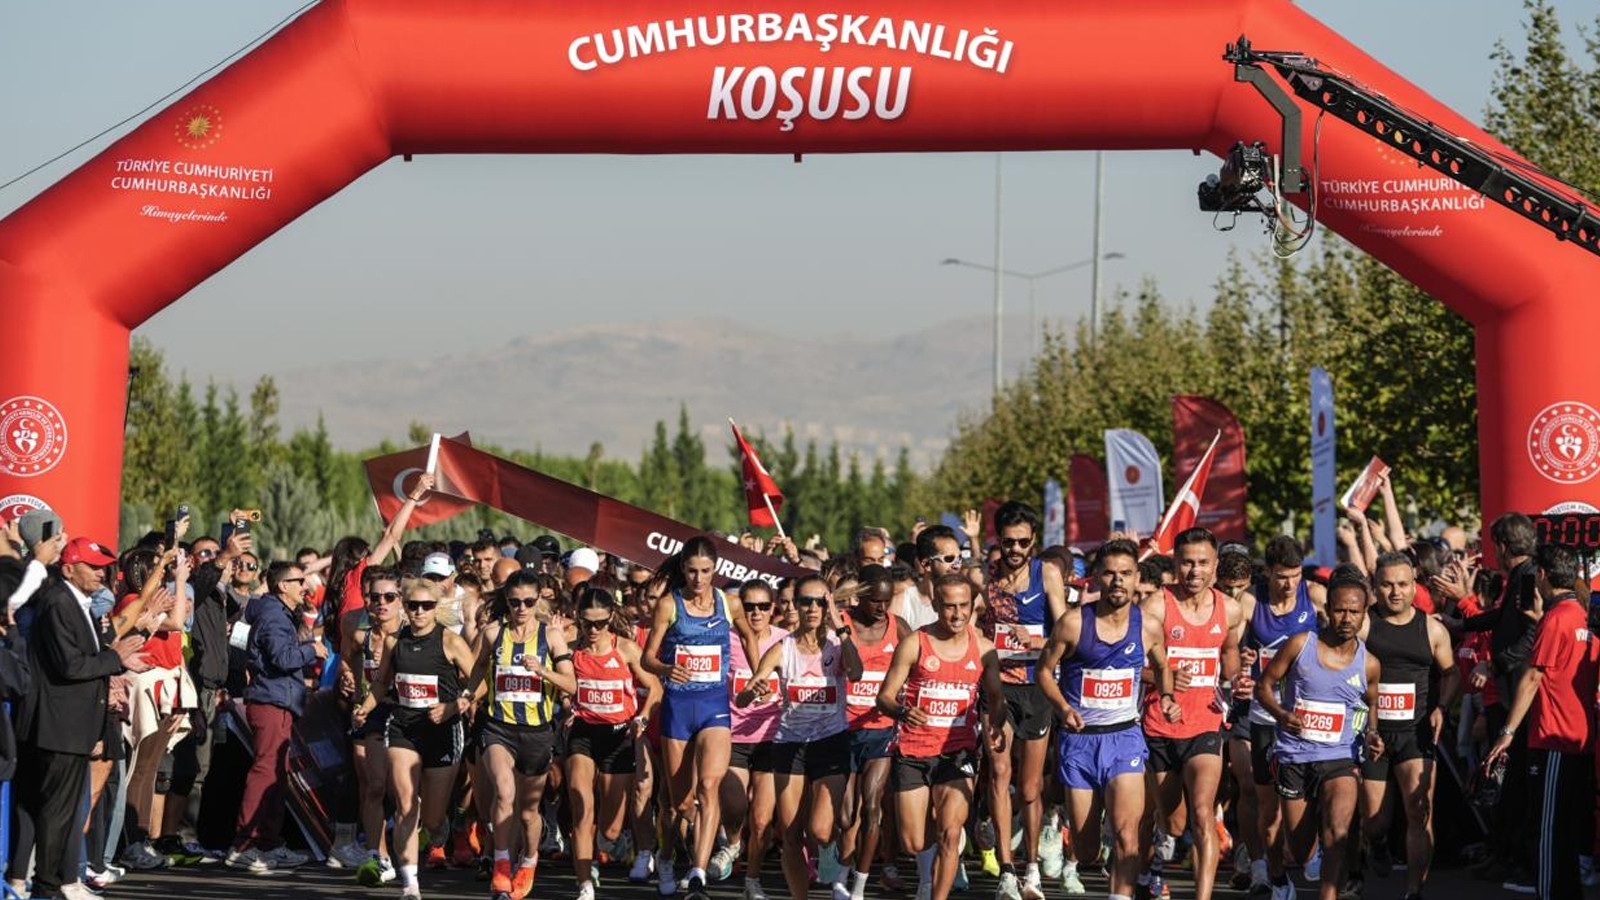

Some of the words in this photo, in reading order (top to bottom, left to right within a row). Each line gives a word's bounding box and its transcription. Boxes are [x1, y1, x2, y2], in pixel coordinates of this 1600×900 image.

[567, 12, 1014, 74] CUMHURBAŞKANLIĞI
[706, 66, 912, 132] KOŞUSU
[116, 158, 171, 174] TÜRKİYE
[173, 161, 273, 183] CUMHURİYETİ
[111, 176, 272, 200] CUMHURBAŞKANLIĞI
[1321, 179, 1379, 194] TÜRKİYE
[1359, 224, 1444, 238] yelerinde
[685, 657, 713, 671] 0920
[797, 688, 828, 703] 0829
[852, 682, 880, 696] 0294
[1094, 682, 1124, 697] 0925
[587, 690, 614, 704] 0649
[1378, 694, 1406, 709] 0018
[929, 700, 959, 715] 0346
[1303, 713, 1334, 731] 0269
